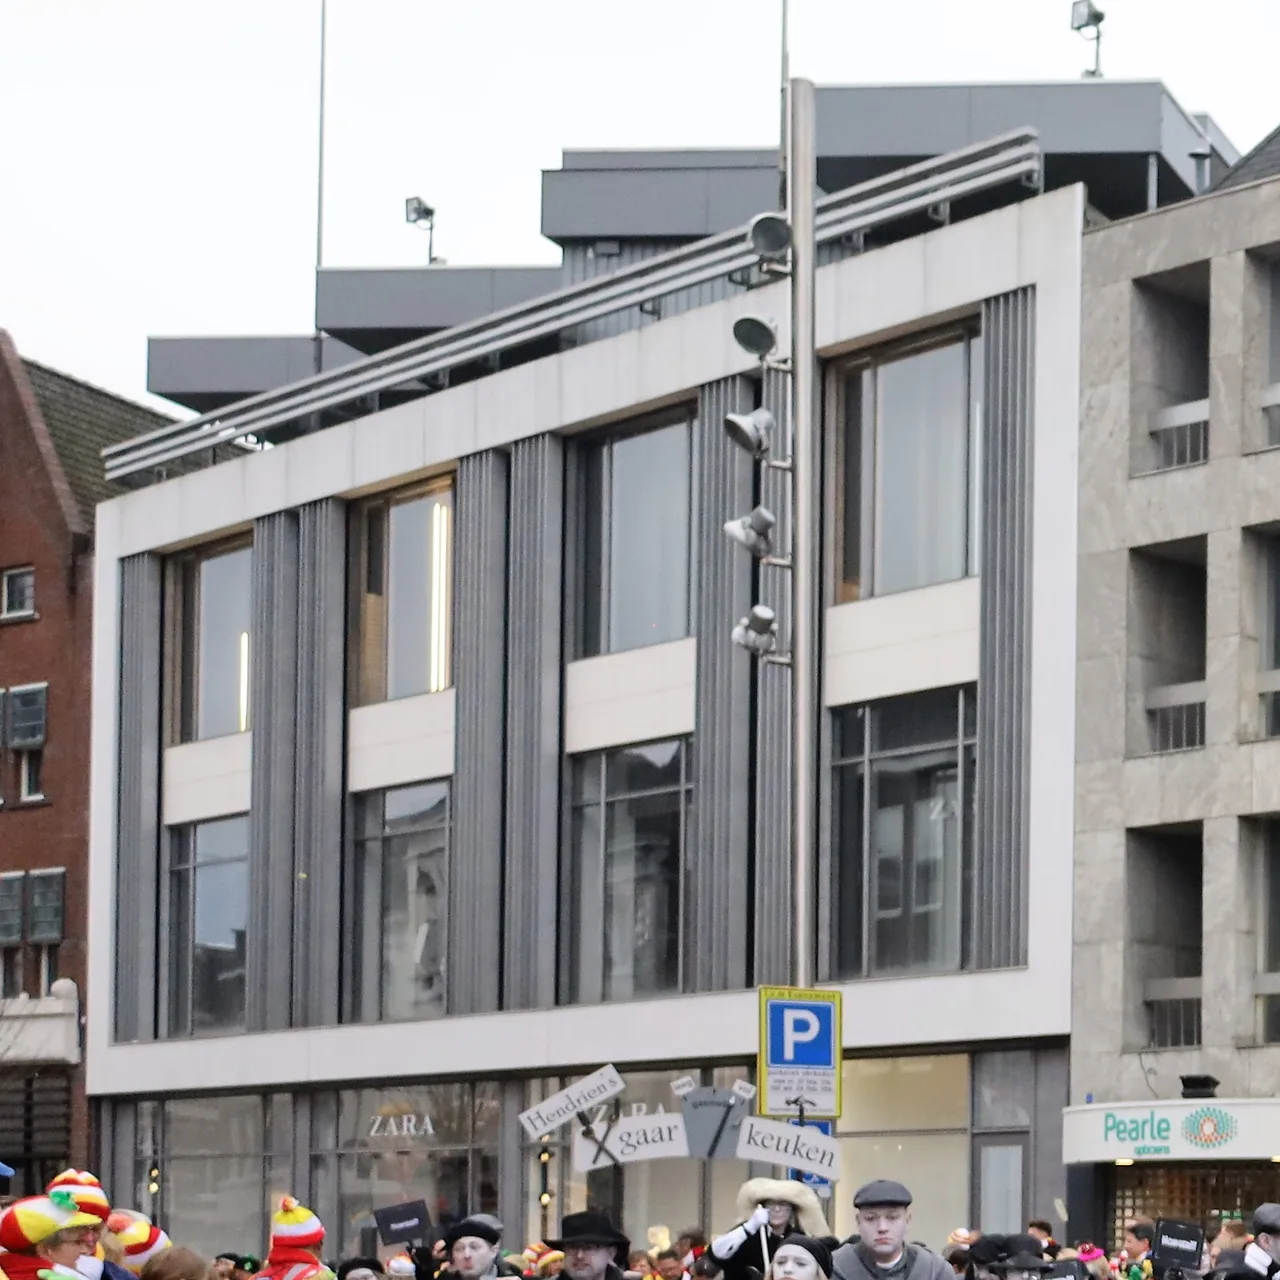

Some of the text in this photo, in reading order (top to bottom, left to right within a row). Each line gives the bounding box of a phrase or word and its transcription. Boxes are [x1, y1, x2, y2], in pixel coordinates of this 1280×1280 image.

[783, 1008, 820, 1062] P
[369, 1114, 436, 1136] ZARA
[527, 1072, 618, 1132] Hendrien's
[619, 1122, 835, 1168] gaar keuken
[1104, 1109, 1171, 1142] Pearle
